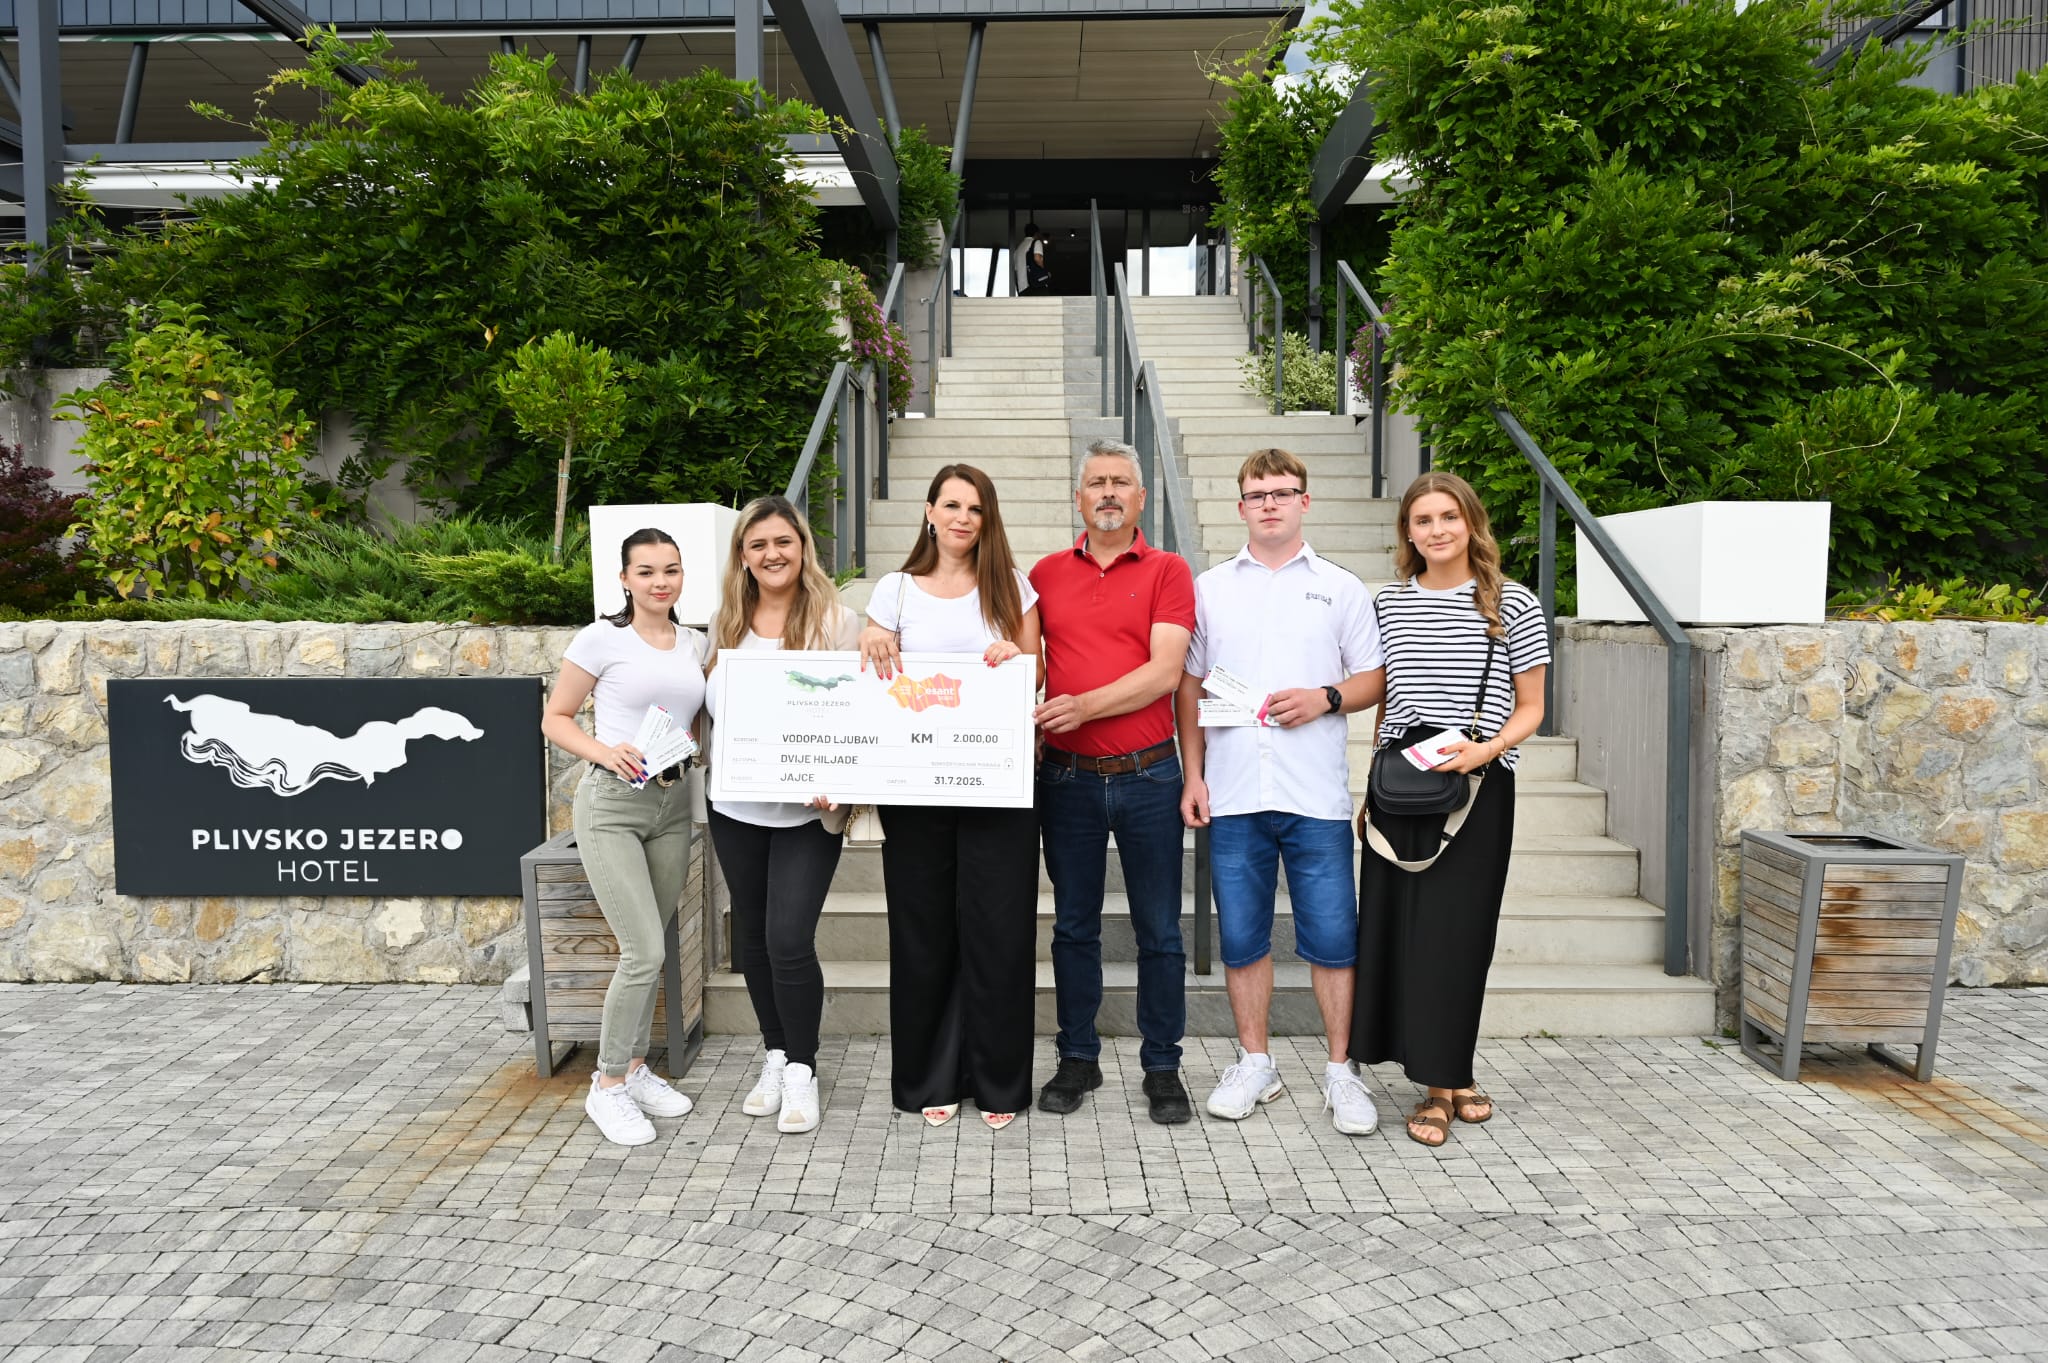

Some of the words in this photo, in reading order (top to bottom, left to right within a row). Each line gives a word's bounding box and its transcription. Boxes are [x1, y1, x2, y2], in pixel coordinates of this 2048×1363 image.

[787, 699, 820, 707] PLIVSKO
[782, 734, 832, 744] VODOPAD
[833, 735, 879, 745] LJUBAVI
[911, 732, 933, 744] KM
[953, 734, 999, 745] 2.000,00
[780, 754, 811, 765] DVIJE
[813, 755, 859, 766] HILJADE
[780, 773, 815, 783] JAJCE
[934, 776, 985, 787] 31.7.2025.
[192, 828, 328, 851] PLIVSKO
[339, 828, 463, 851] JEZERO
[277, 860, 379, 883] HOTEL
